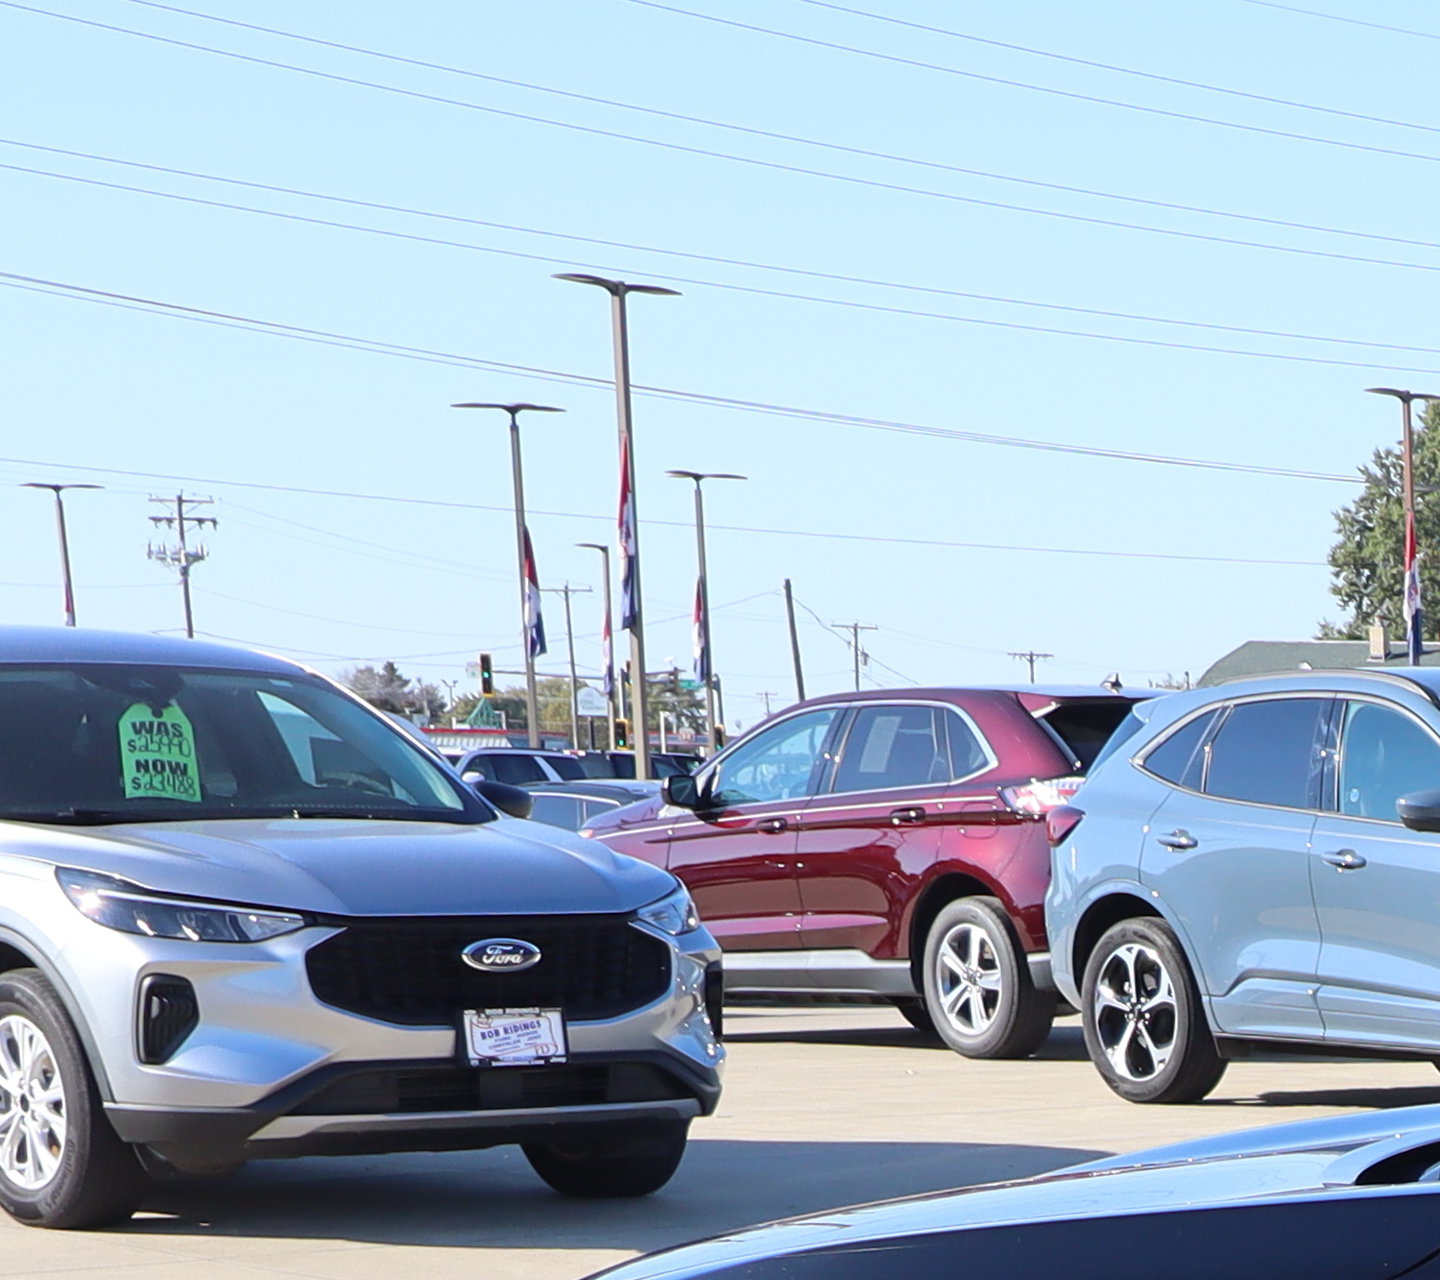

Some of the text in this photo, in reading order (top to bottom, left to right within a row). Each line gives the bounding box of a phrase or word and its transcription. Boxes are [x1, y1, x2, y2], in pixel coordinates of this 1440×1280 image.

[131, 721, 184, 738] WAS
[134, 759, 188, 777] NOW
[482, 944, 527, 965] Ford
[480, 1029, 501, 1041] BOB
[503, 1019, 541, 1035] RIDINGS
